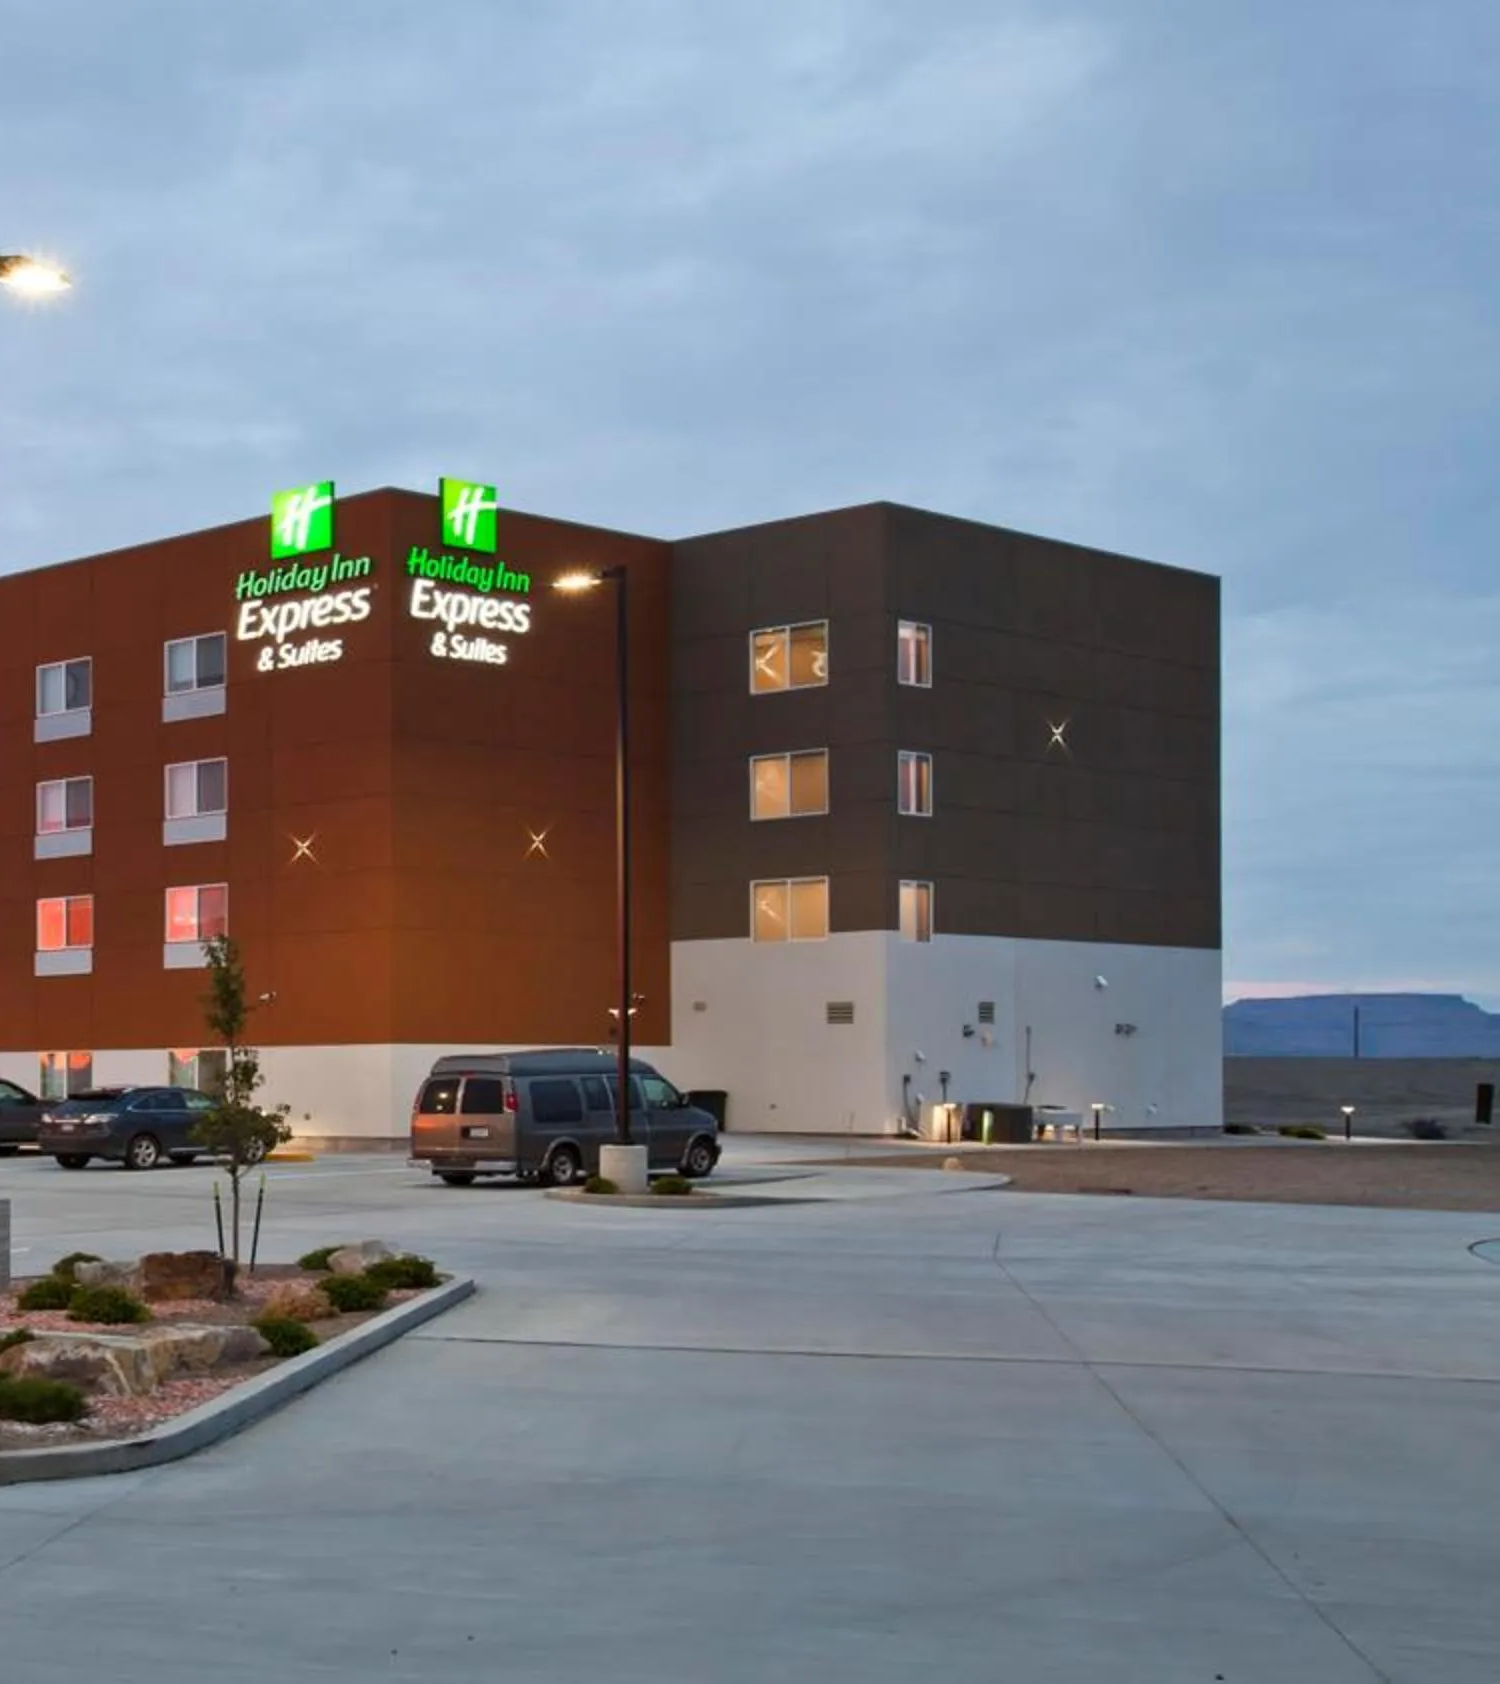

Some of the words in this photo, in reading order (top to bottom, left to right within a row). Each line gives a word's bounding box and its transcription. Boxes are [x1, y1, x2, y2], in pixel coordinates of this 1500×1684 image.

[236, 563, 328, 600] Holiday
[331, 553, 370, 581] Inn
[407, 546, 494, 593] Holiday
[496, 561, 530, 593] Inn
[237, 587, 371, 643] Express
[410, 577, 531, 633] Express
[257, 646, 274, 672] &
[276, 639, 343, 669] Suites
[430, 631, 447, 657] &
[449, 633, 508, 665] Suites
